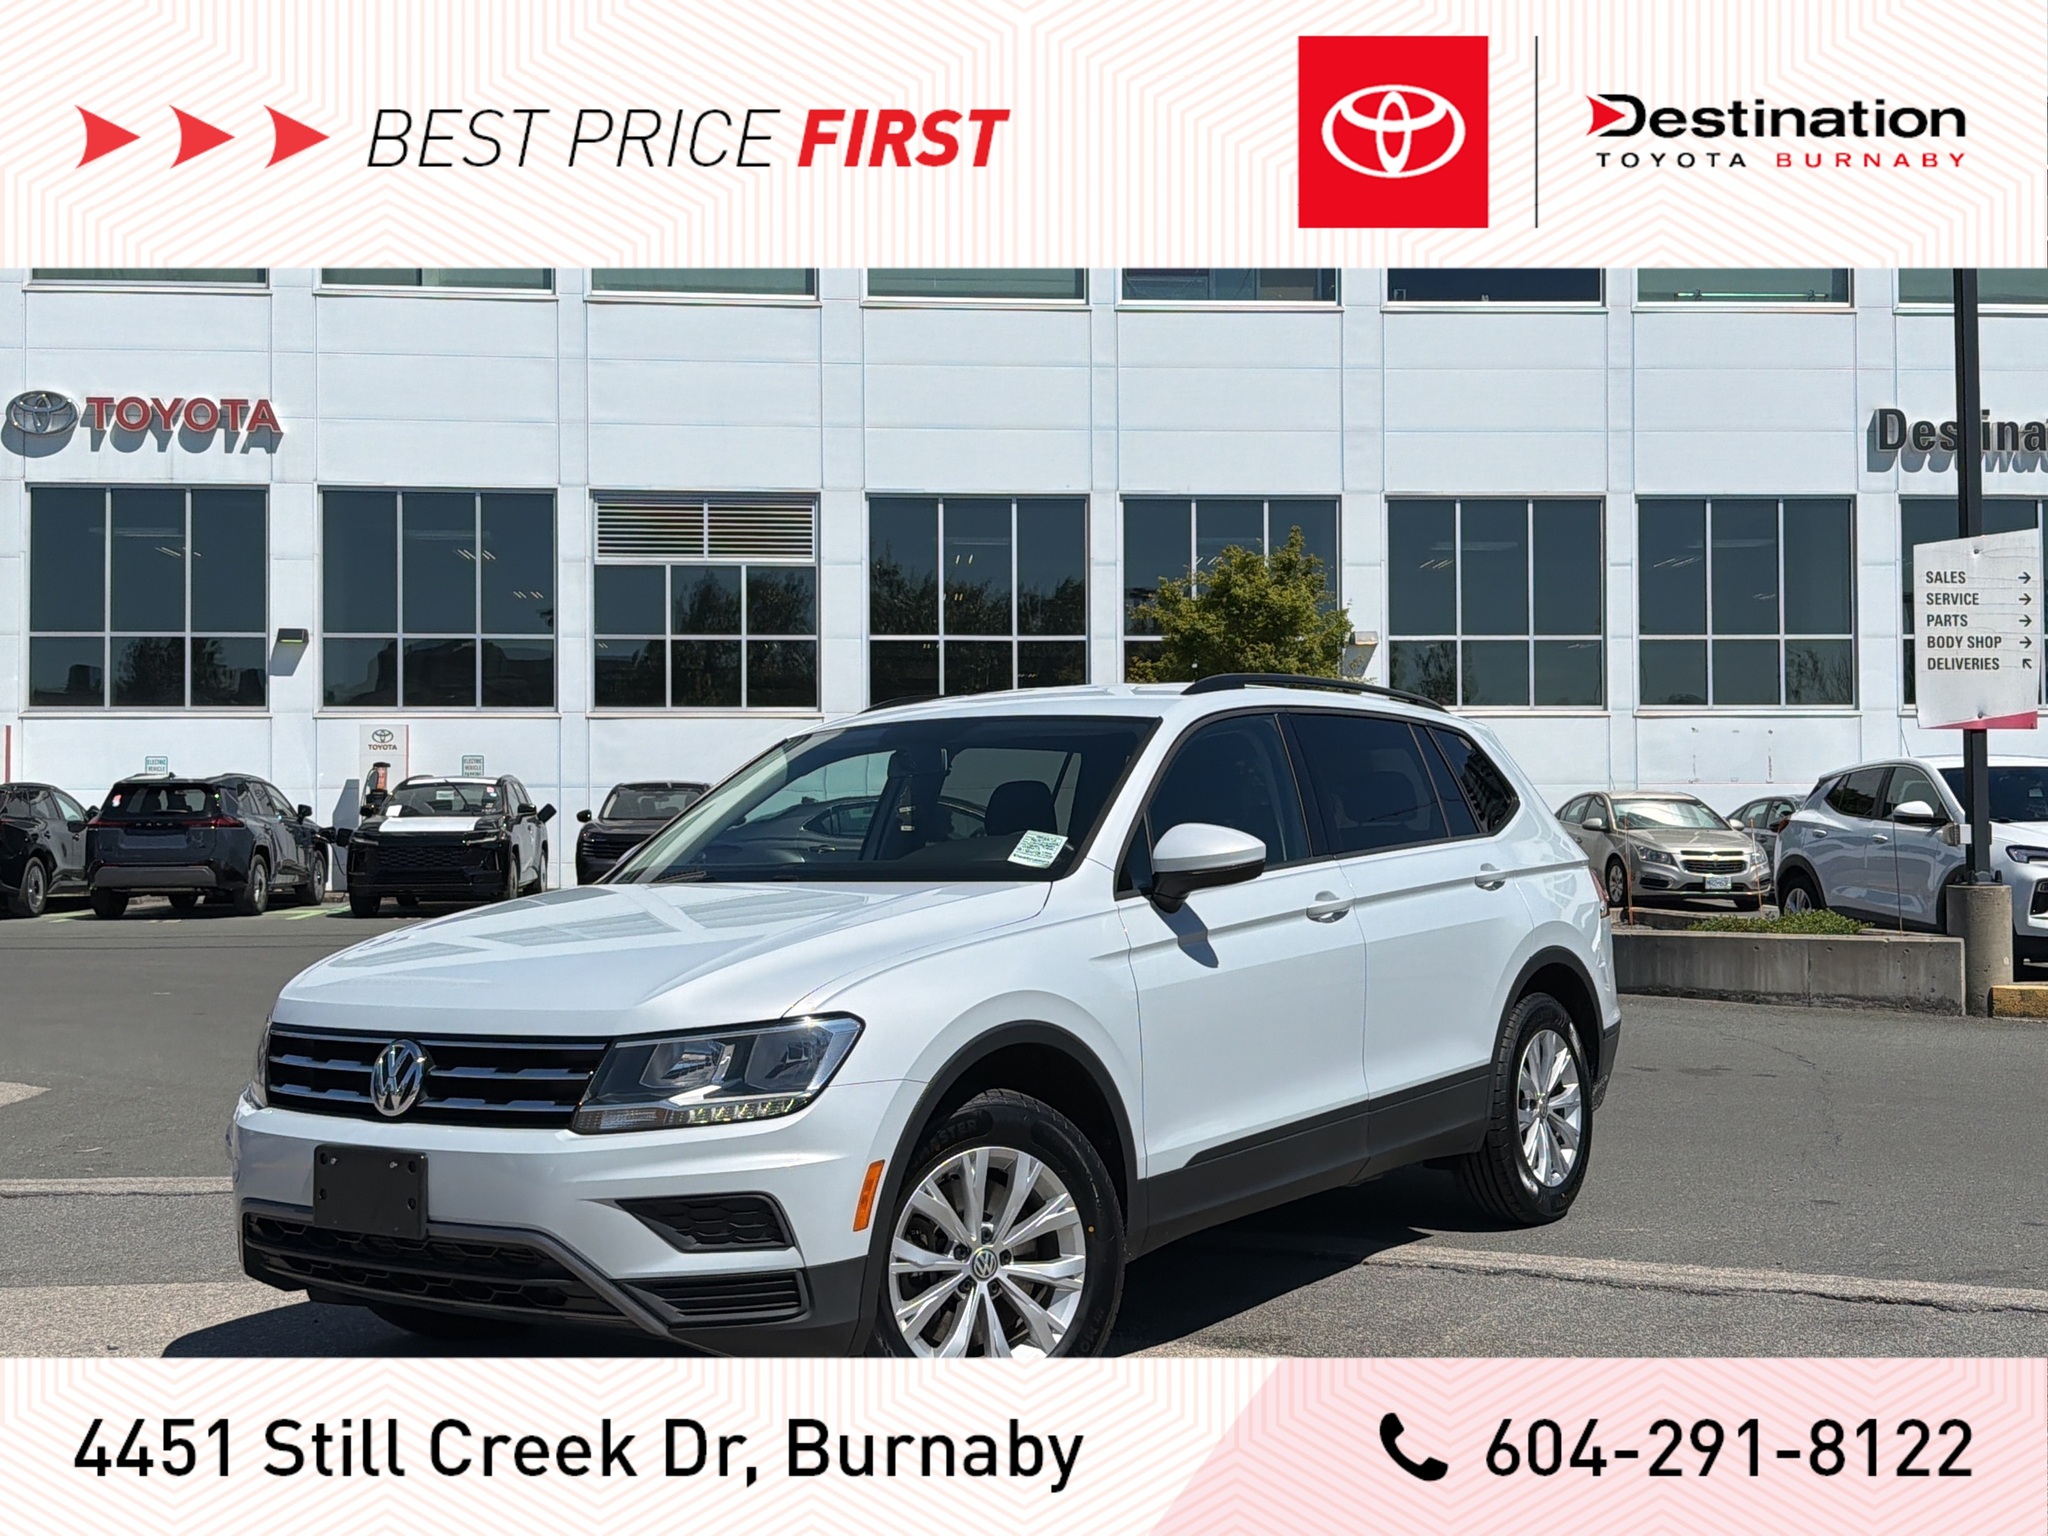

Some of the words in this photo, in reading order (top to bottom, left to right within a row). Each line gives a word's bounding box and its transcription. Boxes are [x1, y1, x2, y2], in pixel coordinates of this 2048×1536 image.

[85, 395, 282, 433] TOYOTA
[1878, 408, 2048, 451] Desina
[1925, 570, 1967, 584] SALES
[1925, 592, 1980, 606] SERVICE
[1926, 614, 1968, 627] PARTS
[1926, 635, 1964, 649] BODY
[1966, 635, 2002, 649] SHOP
[1927, 657, 2000, 670] DELIVERIES
